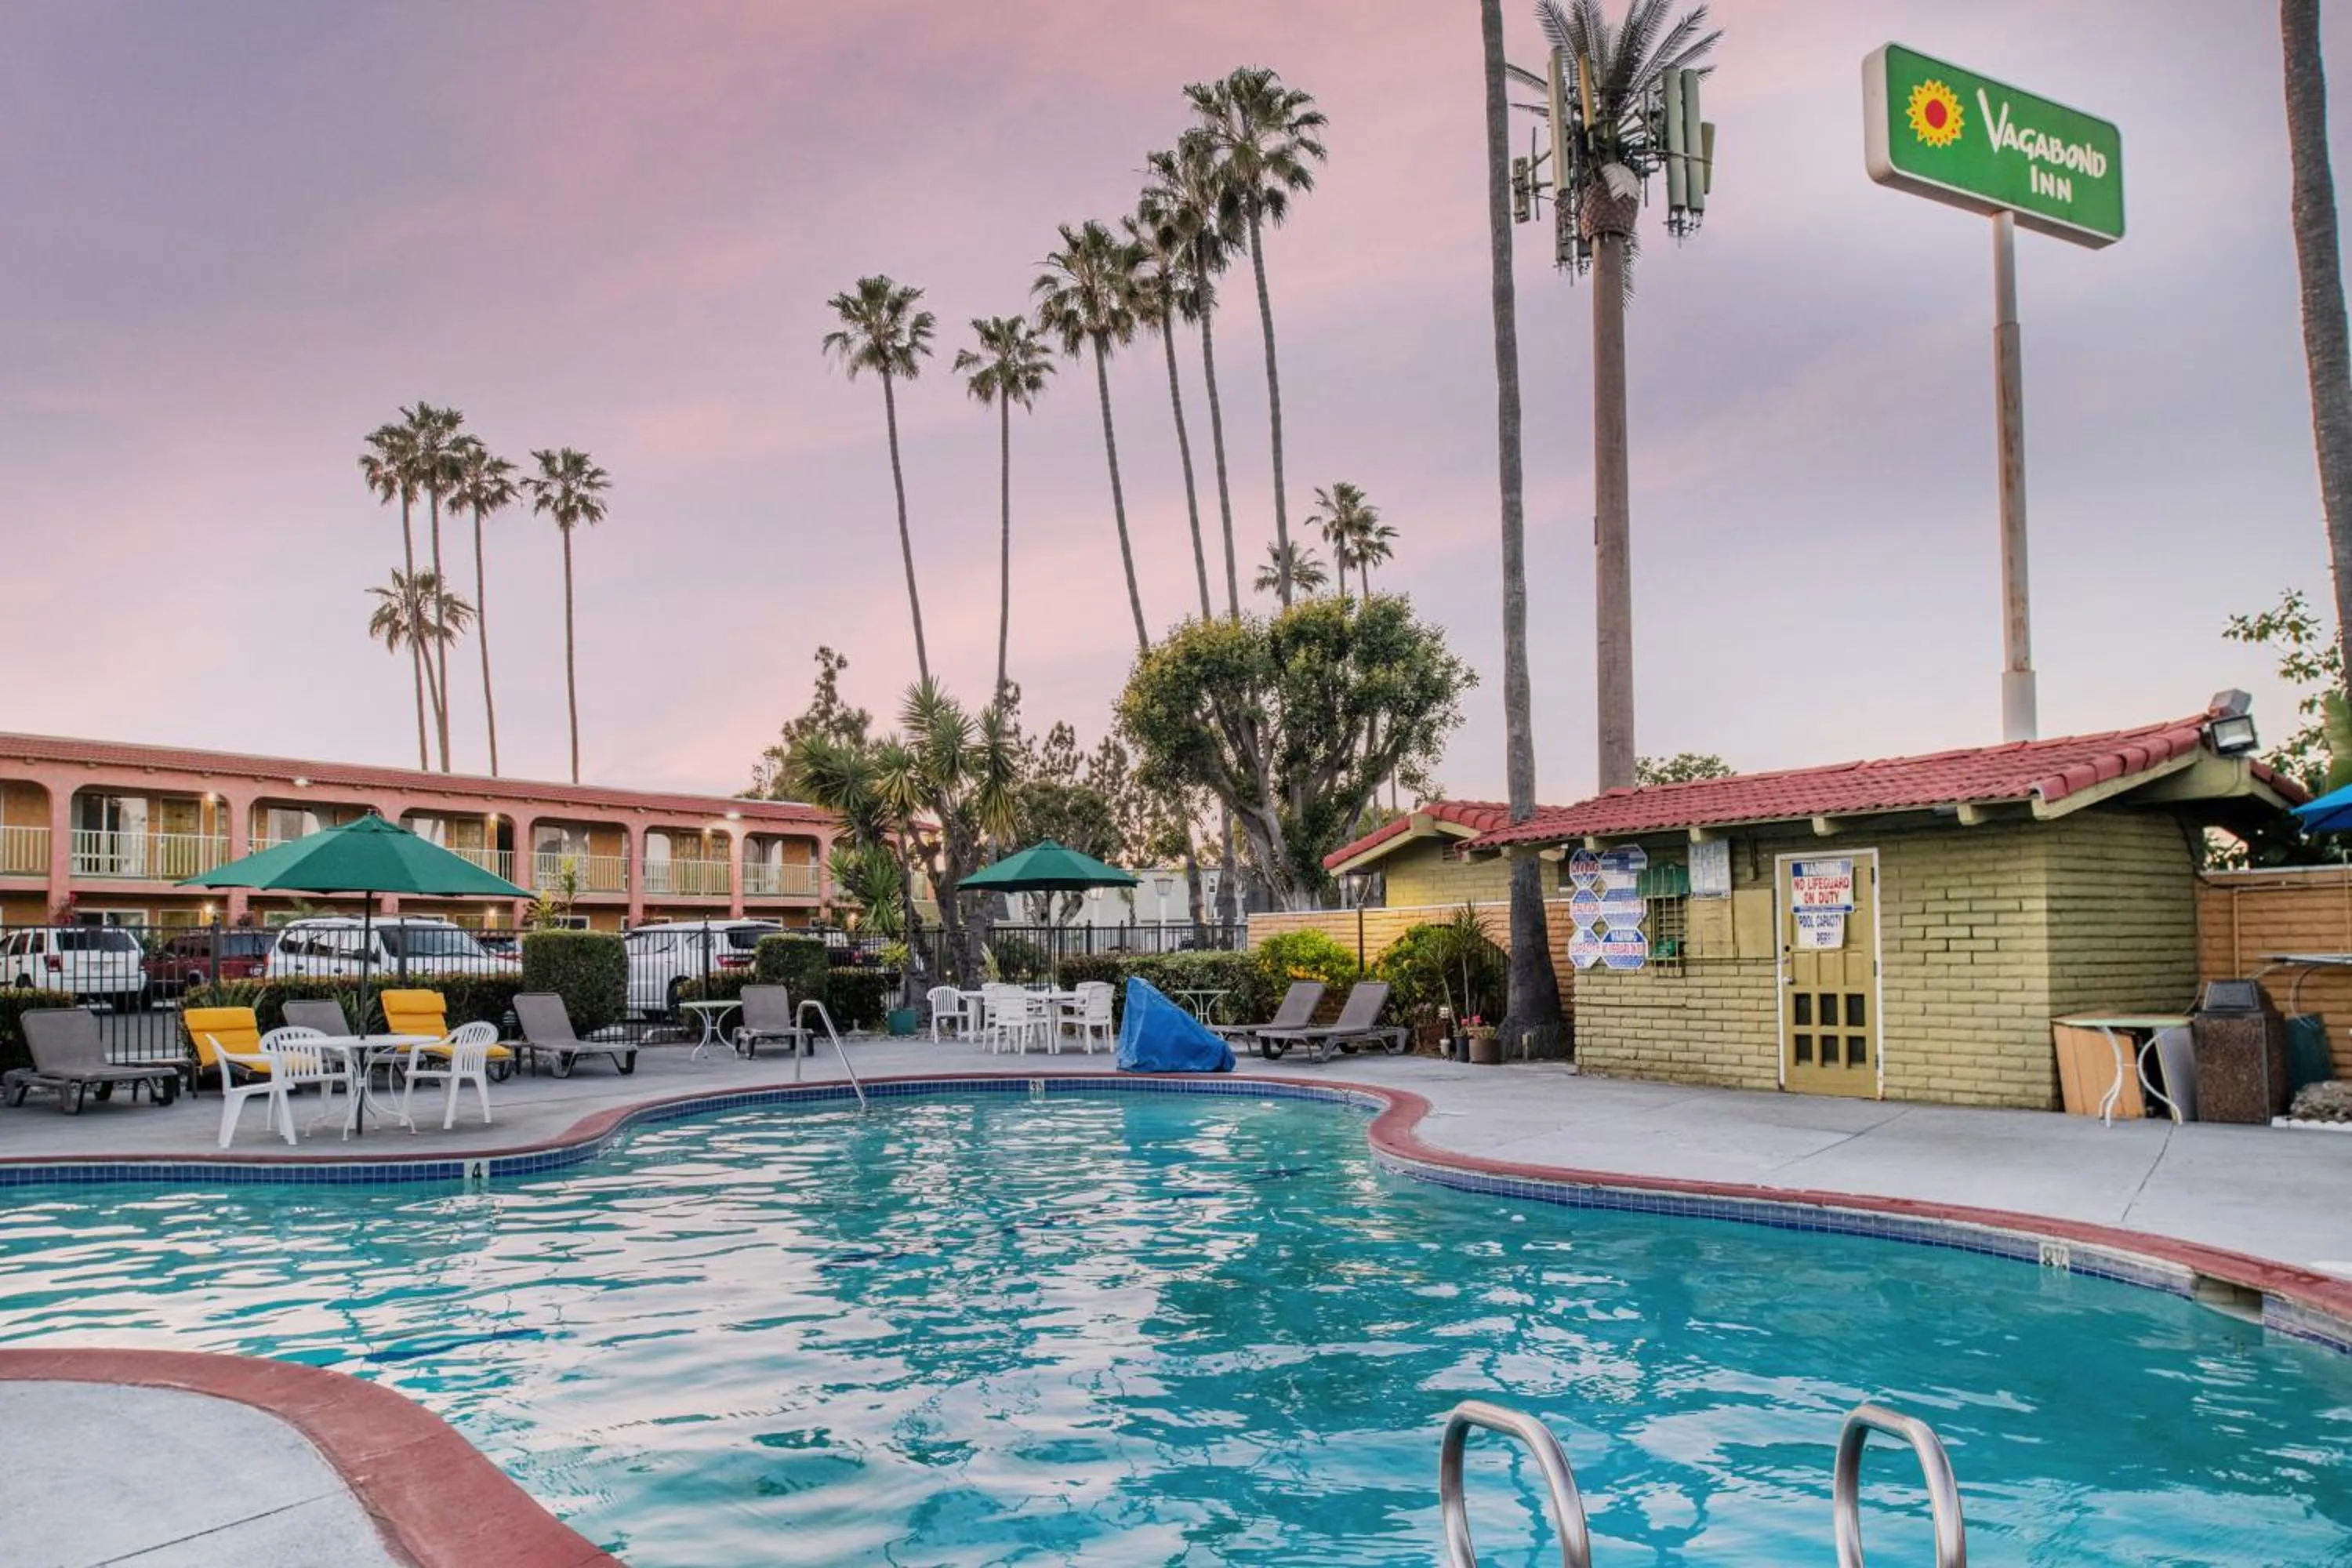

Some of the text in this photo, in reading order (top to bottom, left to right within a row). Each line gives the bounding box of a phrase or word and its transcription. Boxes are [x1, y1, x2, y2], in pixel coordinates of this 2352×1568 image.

[2031, 165, 2072, 203] INN
[1793, 877, 1849, 891] NO LIFEGUARD
[1804, 890, 1839, 904] ON DUTY
[471, 1162, 482, 1178] 4
